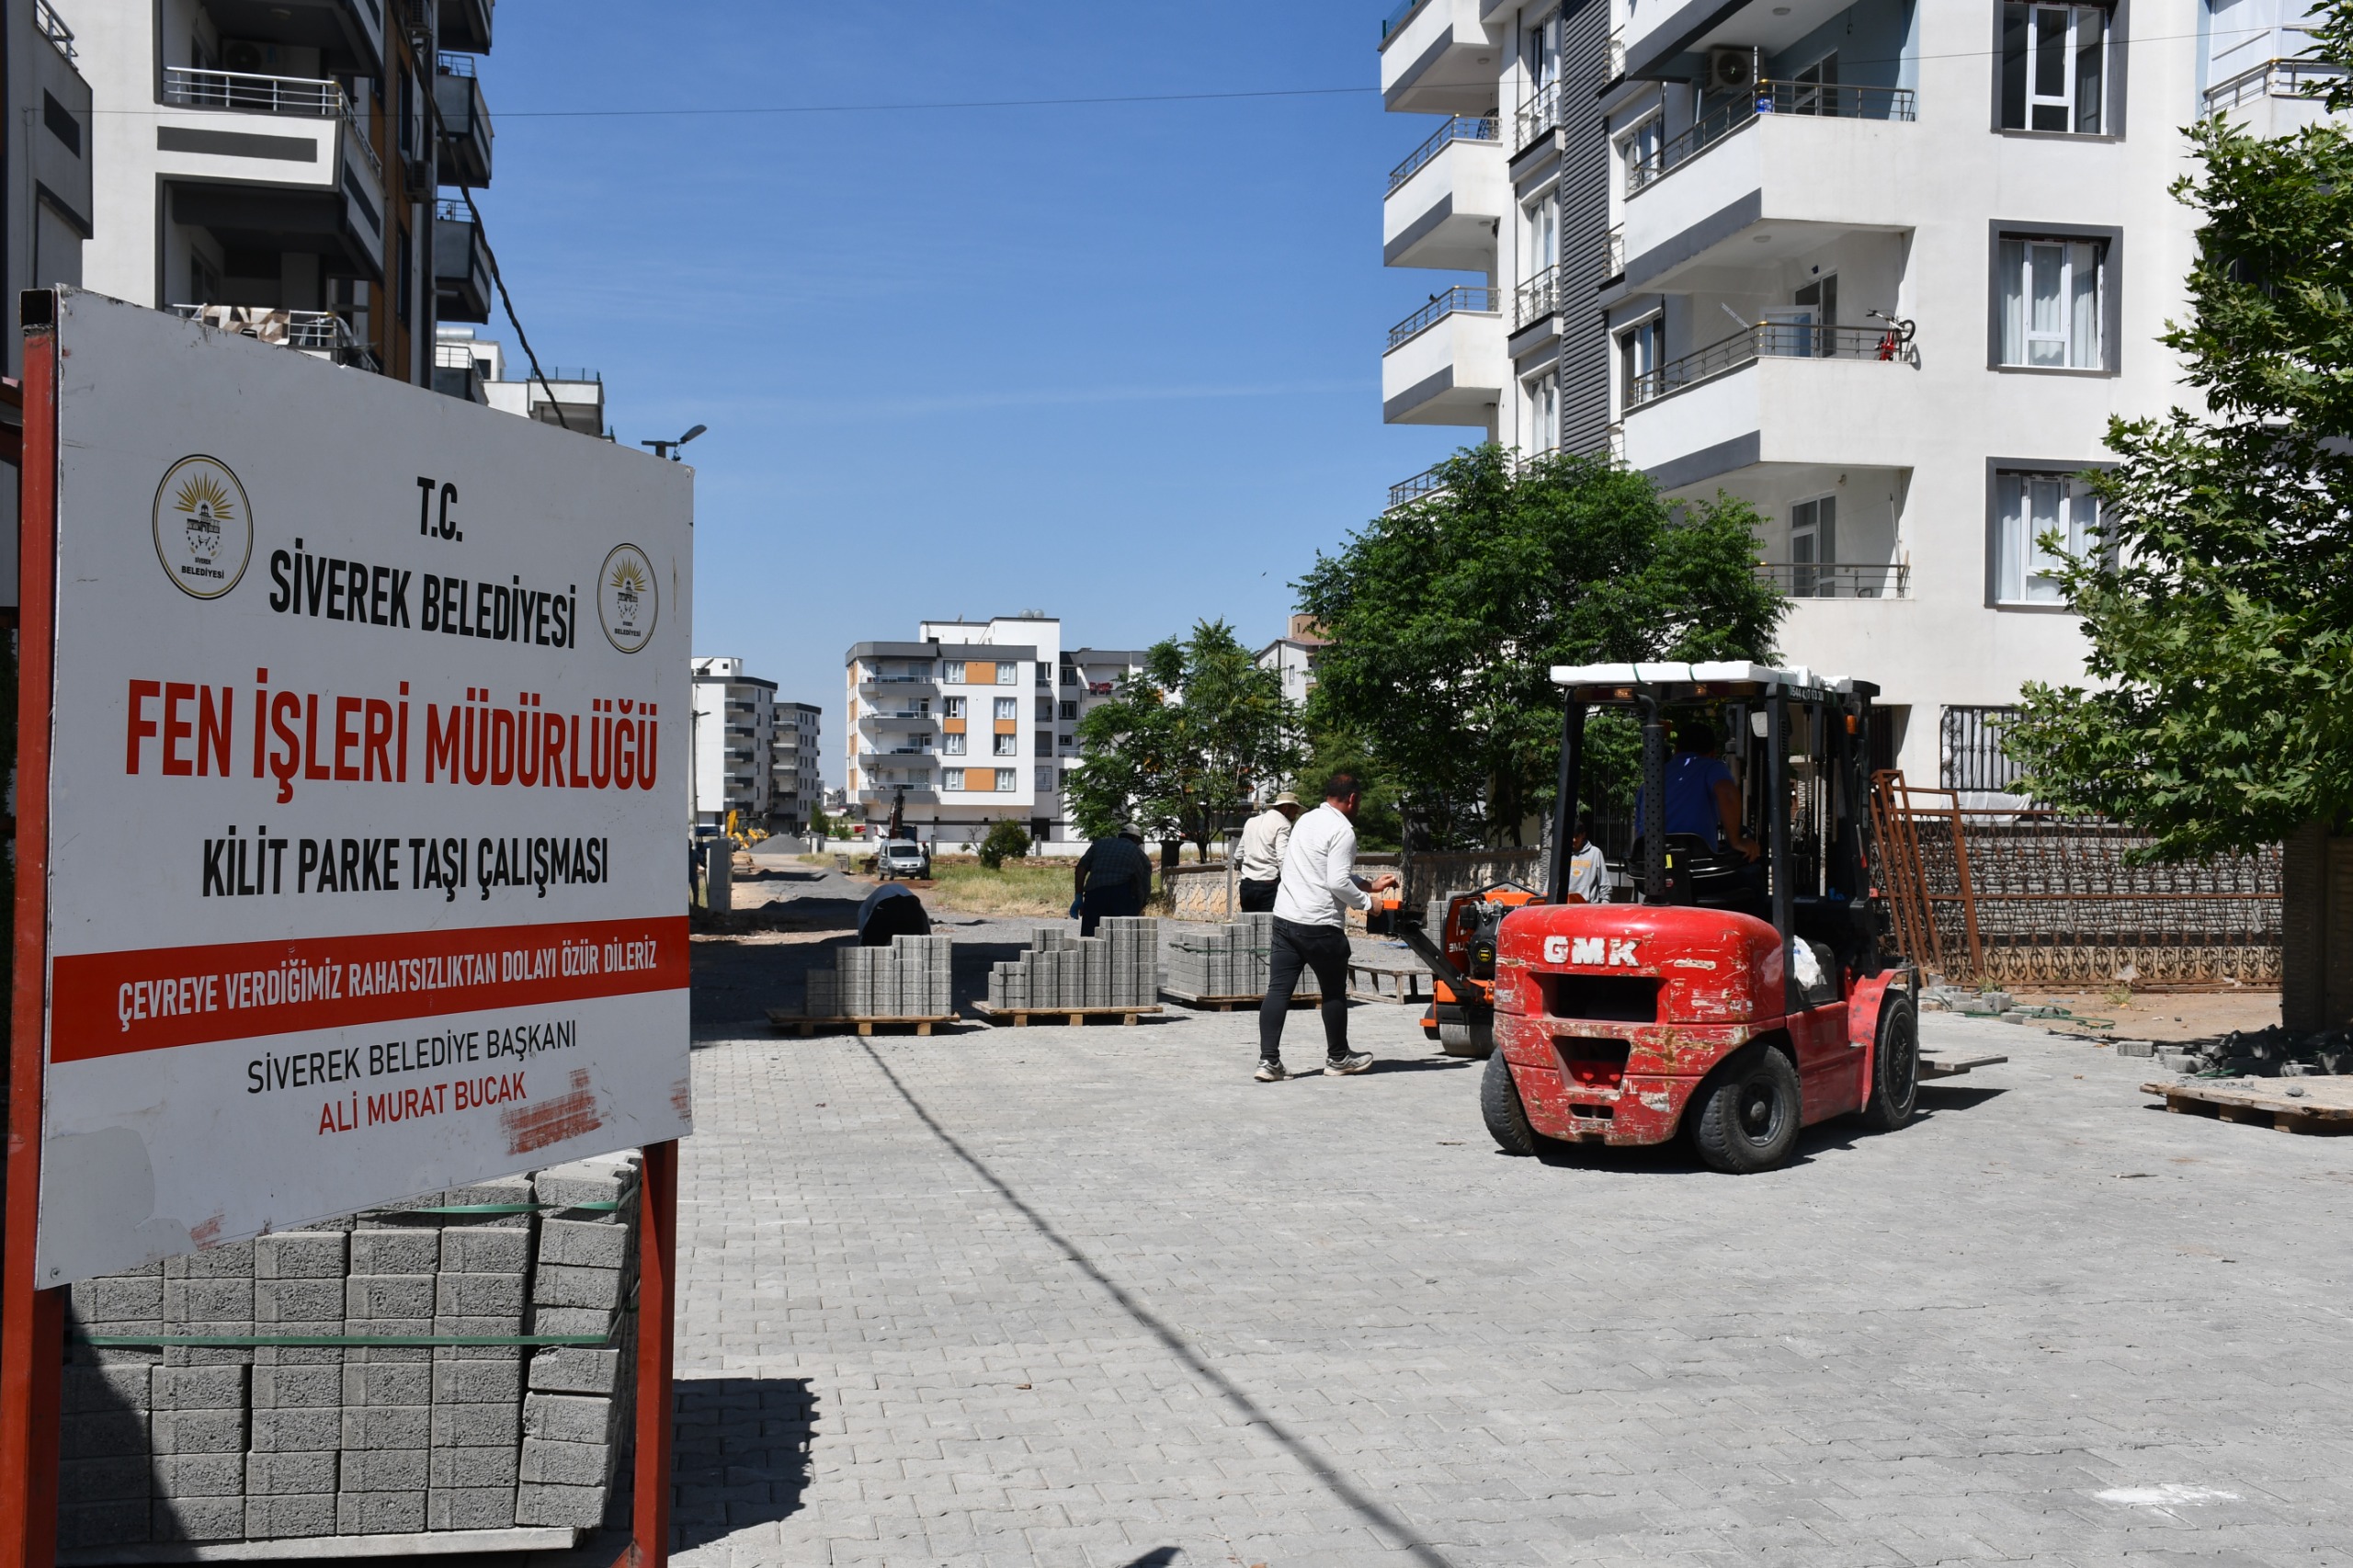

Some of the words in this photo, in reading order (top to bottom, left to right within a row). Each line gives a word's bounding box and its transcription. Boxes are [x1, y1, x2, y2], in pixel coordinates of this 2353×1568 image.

[416, 476, 463, 542] T.C.
[181, 565, 224, 579] BELEDİYESİ
[270, 538, 411, 629] SİVEREK
[422, 574, 575, 649] BELEDİYESİ
[614, 628, 641, 637] BELEDİYESİ
[126, 678, 233, 777] FEN
[254, 668, 408, 803] İŞLERİ
[426, 688, 657, 790] MÜDÜRLÜĞÜ
[203, 825, 288, 896] KİLİT
[298, 839, 399, 893] PARKE
[409, 838, 467, 902] TAŞI
[478, 837, 607, 901] ÇALIŞMASI
[119, 975, 217, 1031] ÇEVREYE
[226, 958, 341, 1008] VERDİĞİMİZ
[349, 953, 495, 996] RAHATSIZLIKTAN
[503, 949, 555, 982] DOLAYI
[562, 944, 599, 977] ÖZÜR
[605, 935, 656, 972] DİLERİZ
[1544, 936, 1641, 967] GMK
[248, 1048, 360, 1093] SİVEREK
[370, 1029, 479, 1075] BELEDİYE
[488, 1020, 575, 1062] BAŞKANI
[318, 1091, 359, 1135] ALİ
[368, 1085, 448, 1124] MURAT
[454, 1072, 527, 1111] BUCAK
